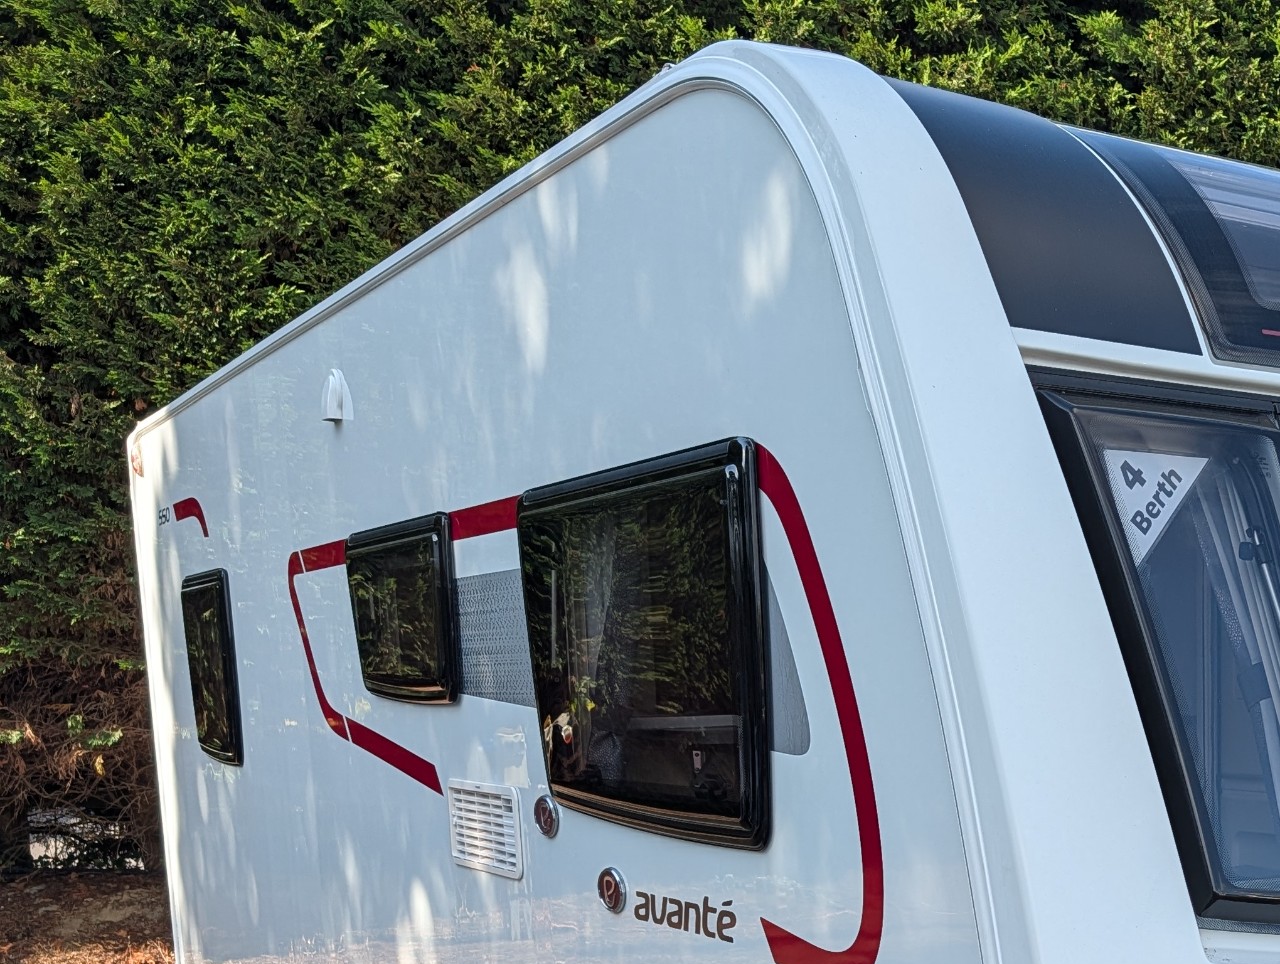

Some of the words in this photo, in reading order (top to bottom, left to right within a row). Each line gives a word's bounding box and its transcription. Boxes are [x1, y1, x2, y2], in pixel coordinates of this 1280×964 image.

[1119, 459, 1147, 491] 4
[158, 506, 171, 526] 550
[1129, 468, 1183, 536] Berth
[633, 890, 738, 944] avanté
